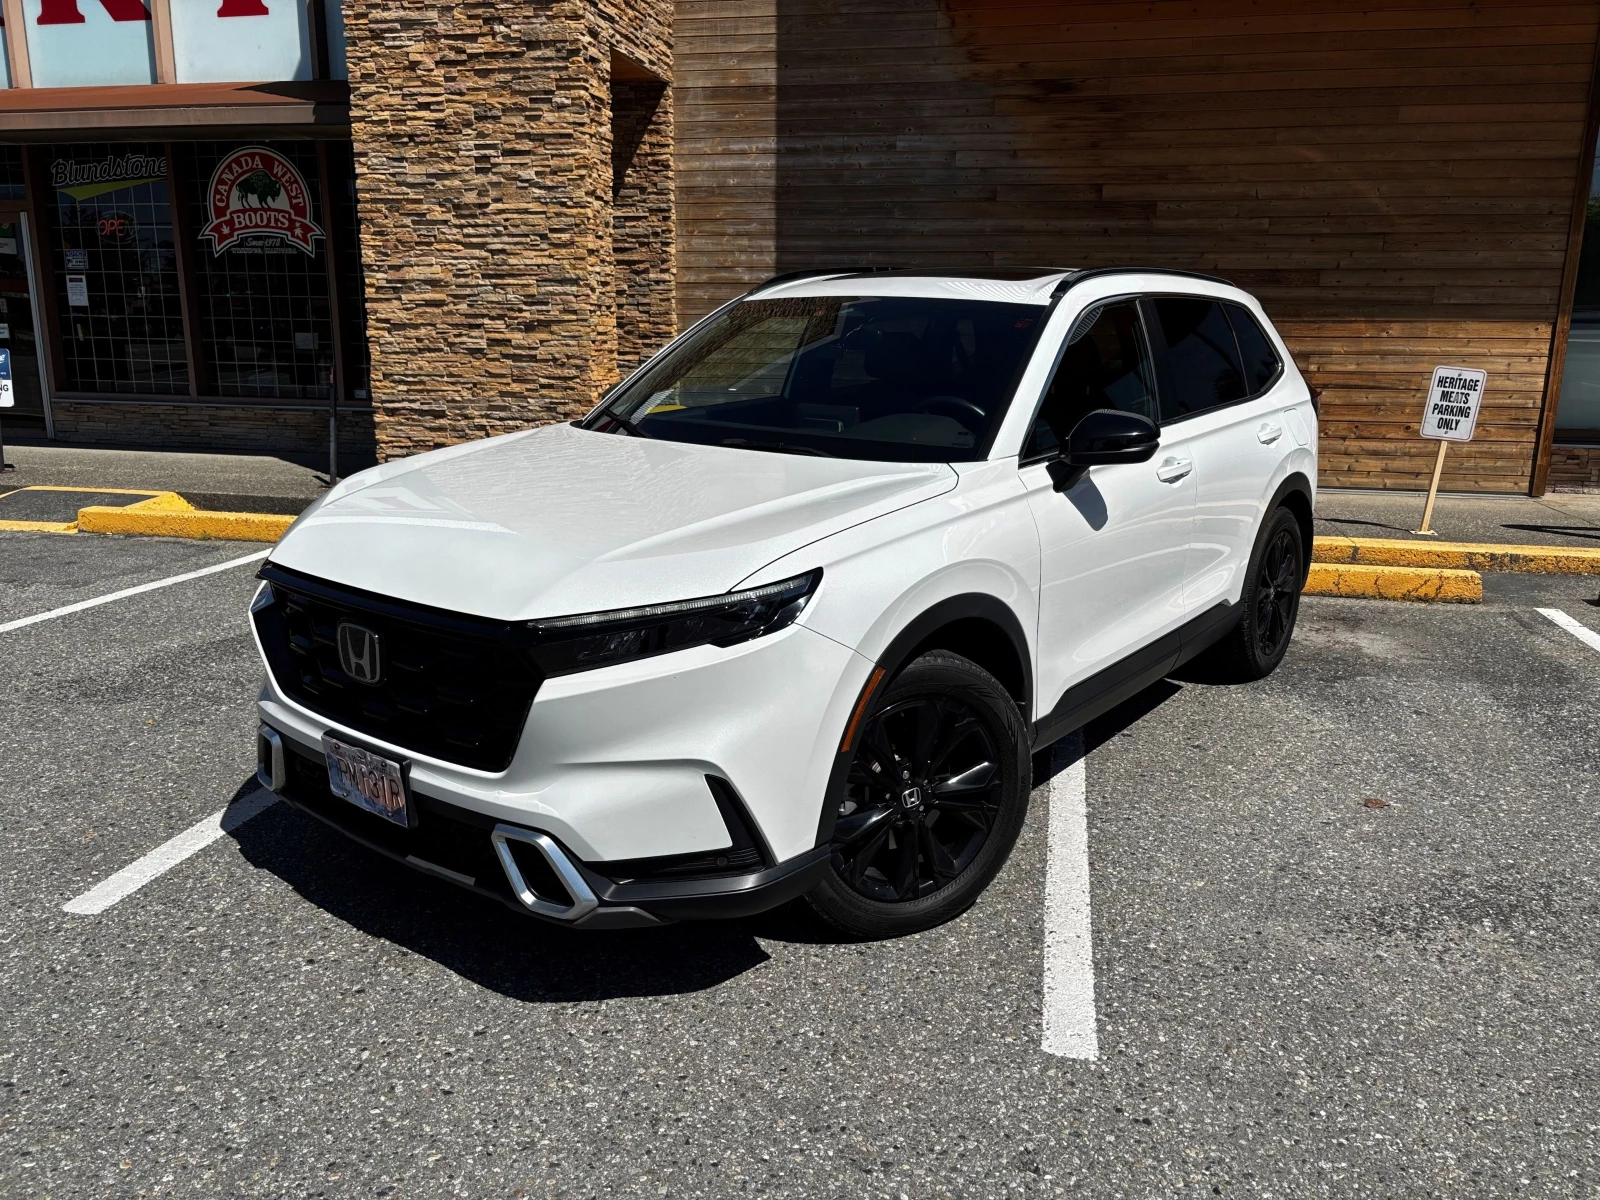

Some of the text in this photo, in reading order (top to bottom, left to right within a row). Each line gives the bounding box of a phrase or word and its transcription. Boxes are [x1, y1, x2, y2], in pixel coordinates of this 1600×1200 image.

[51, 153, 167, 186] Blundstone
[215, 155, 305, 207] CANADA WEST
[232, 210, 290, 229] BOOTS
[1436, 375, 1480, 392] HERITAGE
[1439, 390, 1470, 405] MEATS
[1432, 403, 1471, 418] PARKING
[1437, 417, 1460, 431] ONLY
